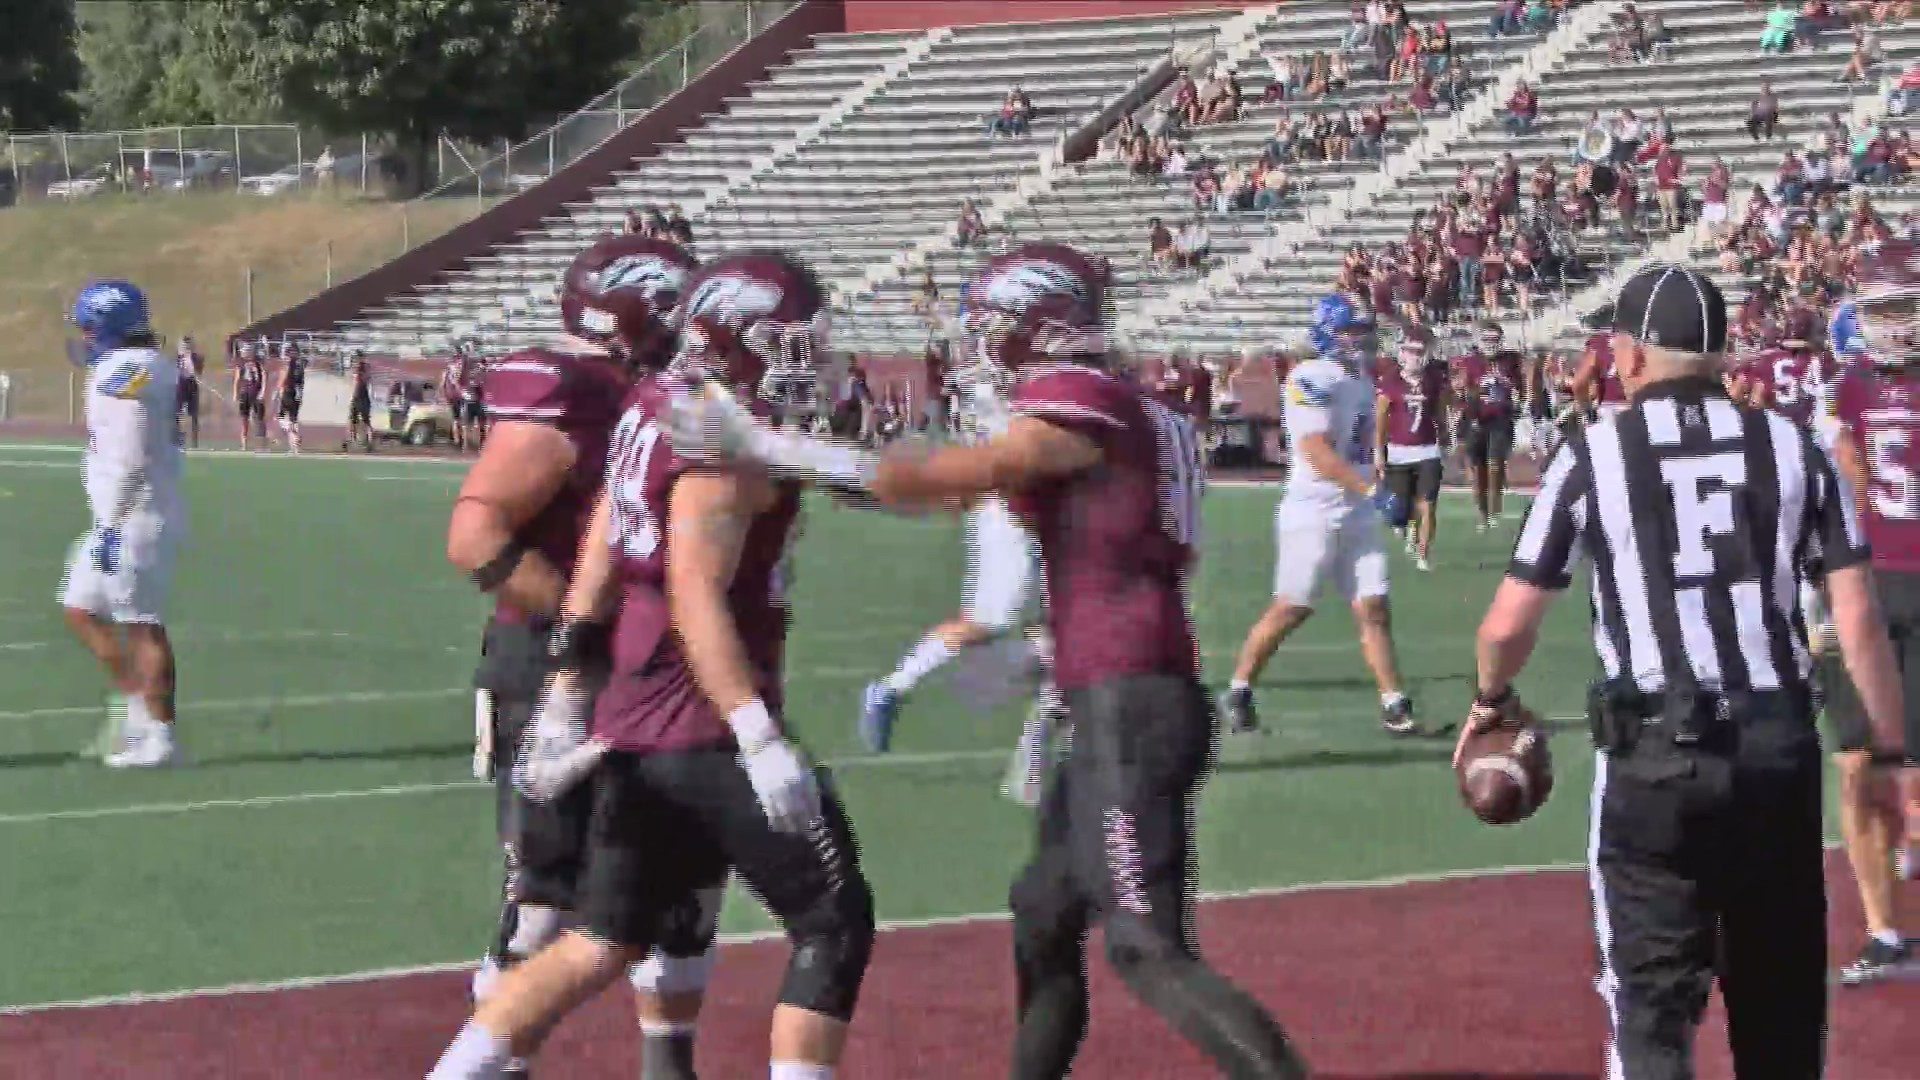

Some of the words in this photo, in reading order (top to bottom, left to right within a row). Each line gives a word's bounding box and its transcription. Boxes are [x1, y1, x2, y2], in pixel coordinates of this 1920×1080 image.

[1773, 356, 1823, 403] 54
[1407, 401, 1423, 432] 7
[1659, 452, 1748, 576] F
